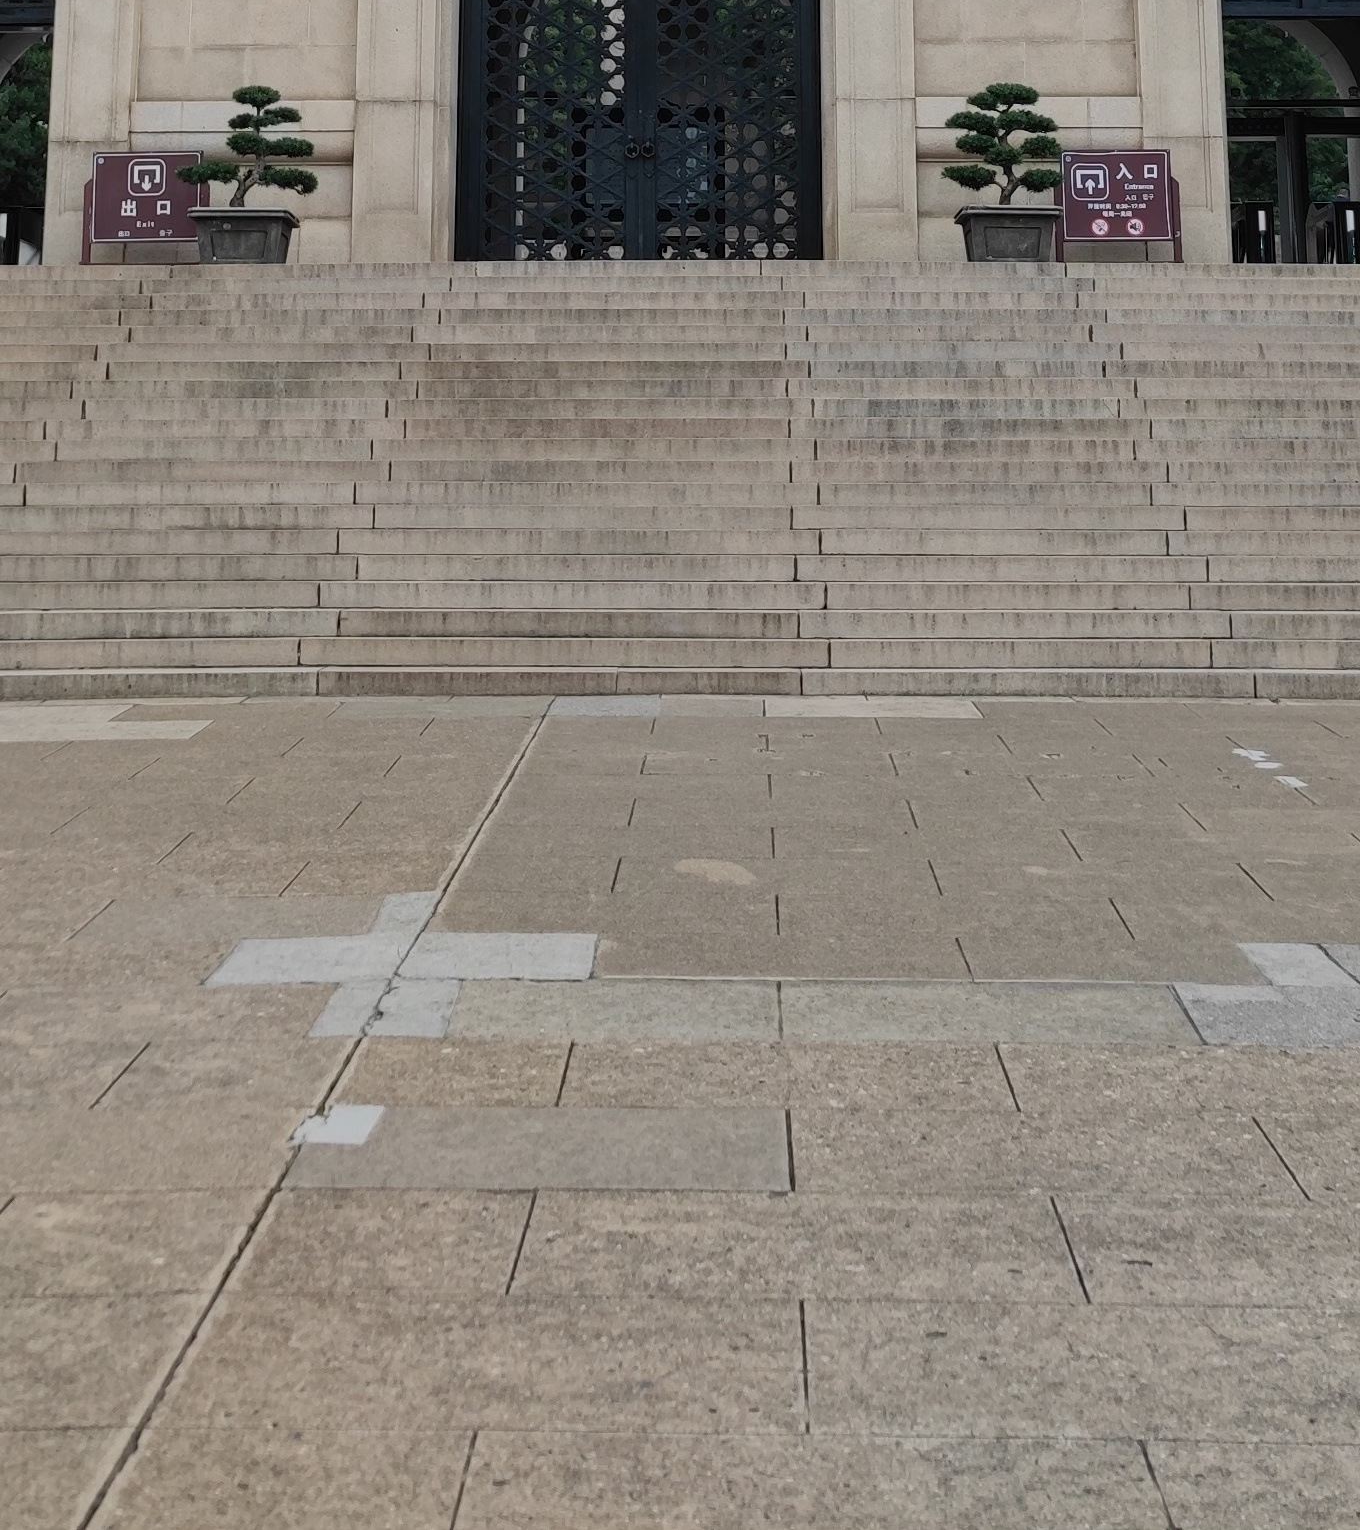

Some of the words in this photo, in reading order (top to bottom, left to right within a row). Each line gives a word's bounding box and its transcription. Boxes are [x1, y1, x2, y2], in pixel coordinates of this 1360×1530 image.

[1115, 162, 1158, 180] 入口
[120, 198, 171, 217] 出口
[136, 220, 155, 228] Exit
